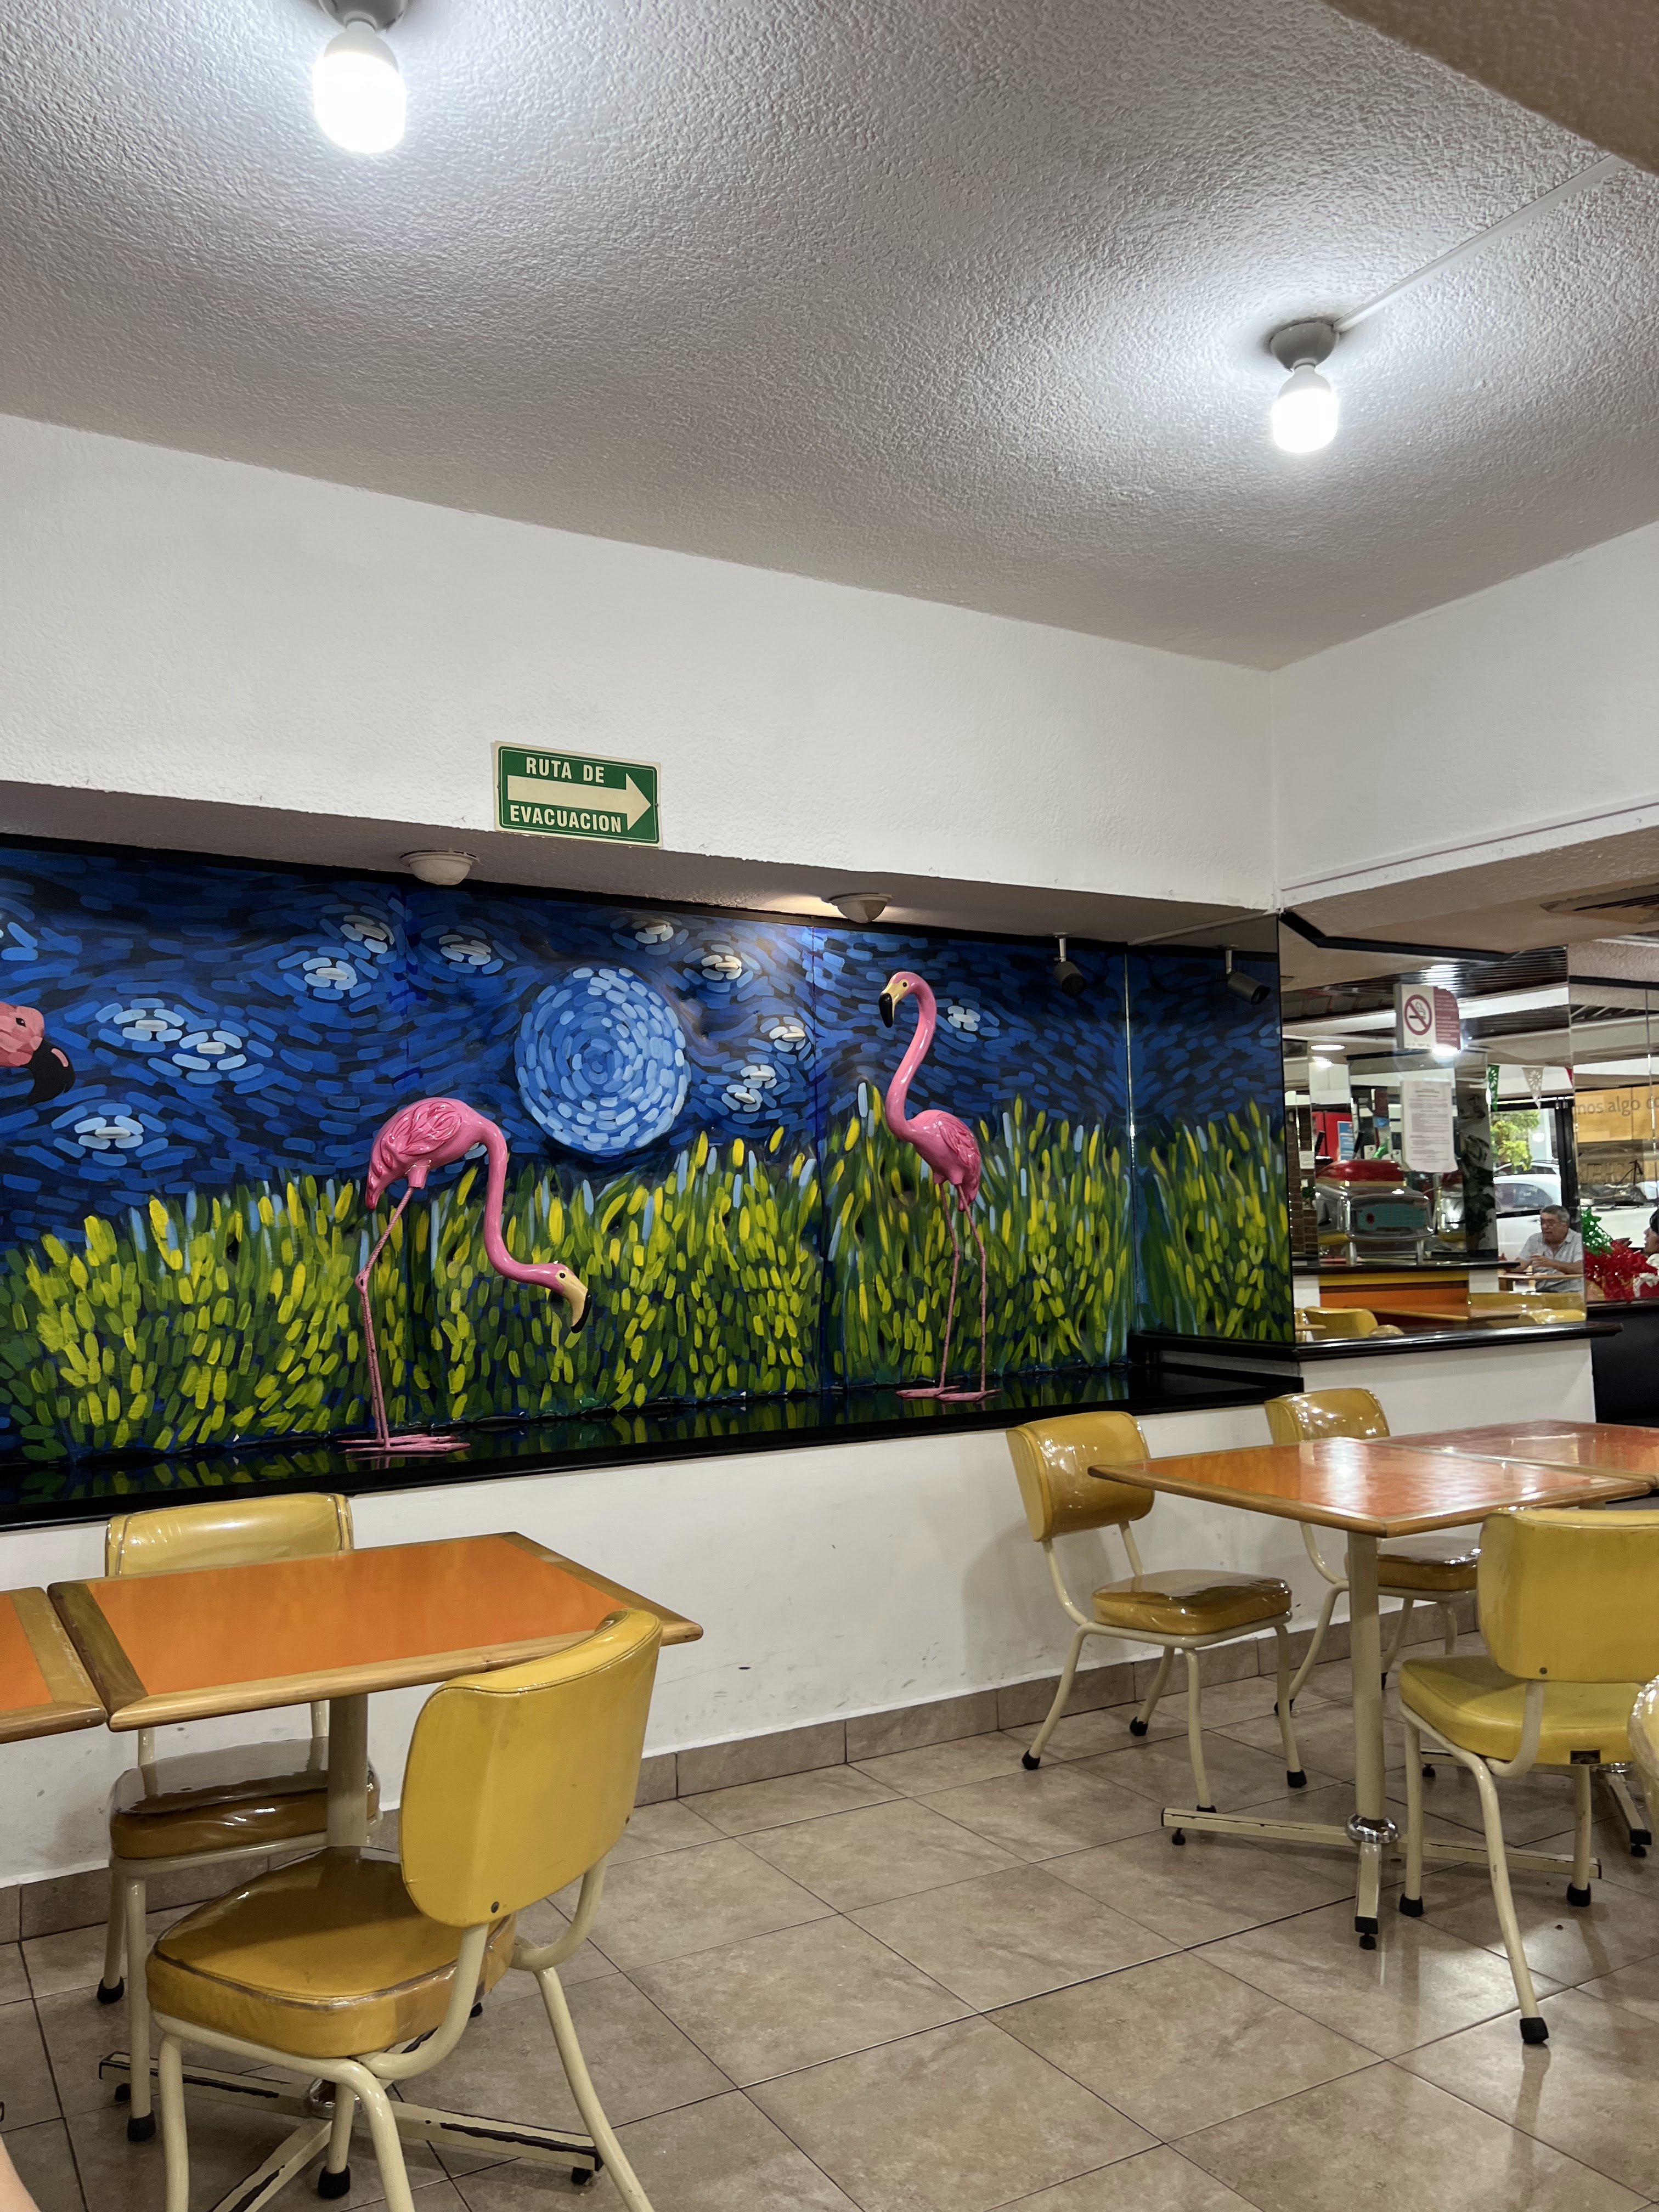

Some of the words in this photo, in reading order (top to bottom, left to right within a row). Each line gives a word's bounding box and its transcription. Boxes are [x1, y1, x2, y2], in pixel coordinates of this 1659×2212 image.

[526, 757, 572, 780] RUTA
[583, 764, 605, 783] DE
[510, 804, 622, 833] EVACUACION
[1608, 1096, 1641, 1116] algo
